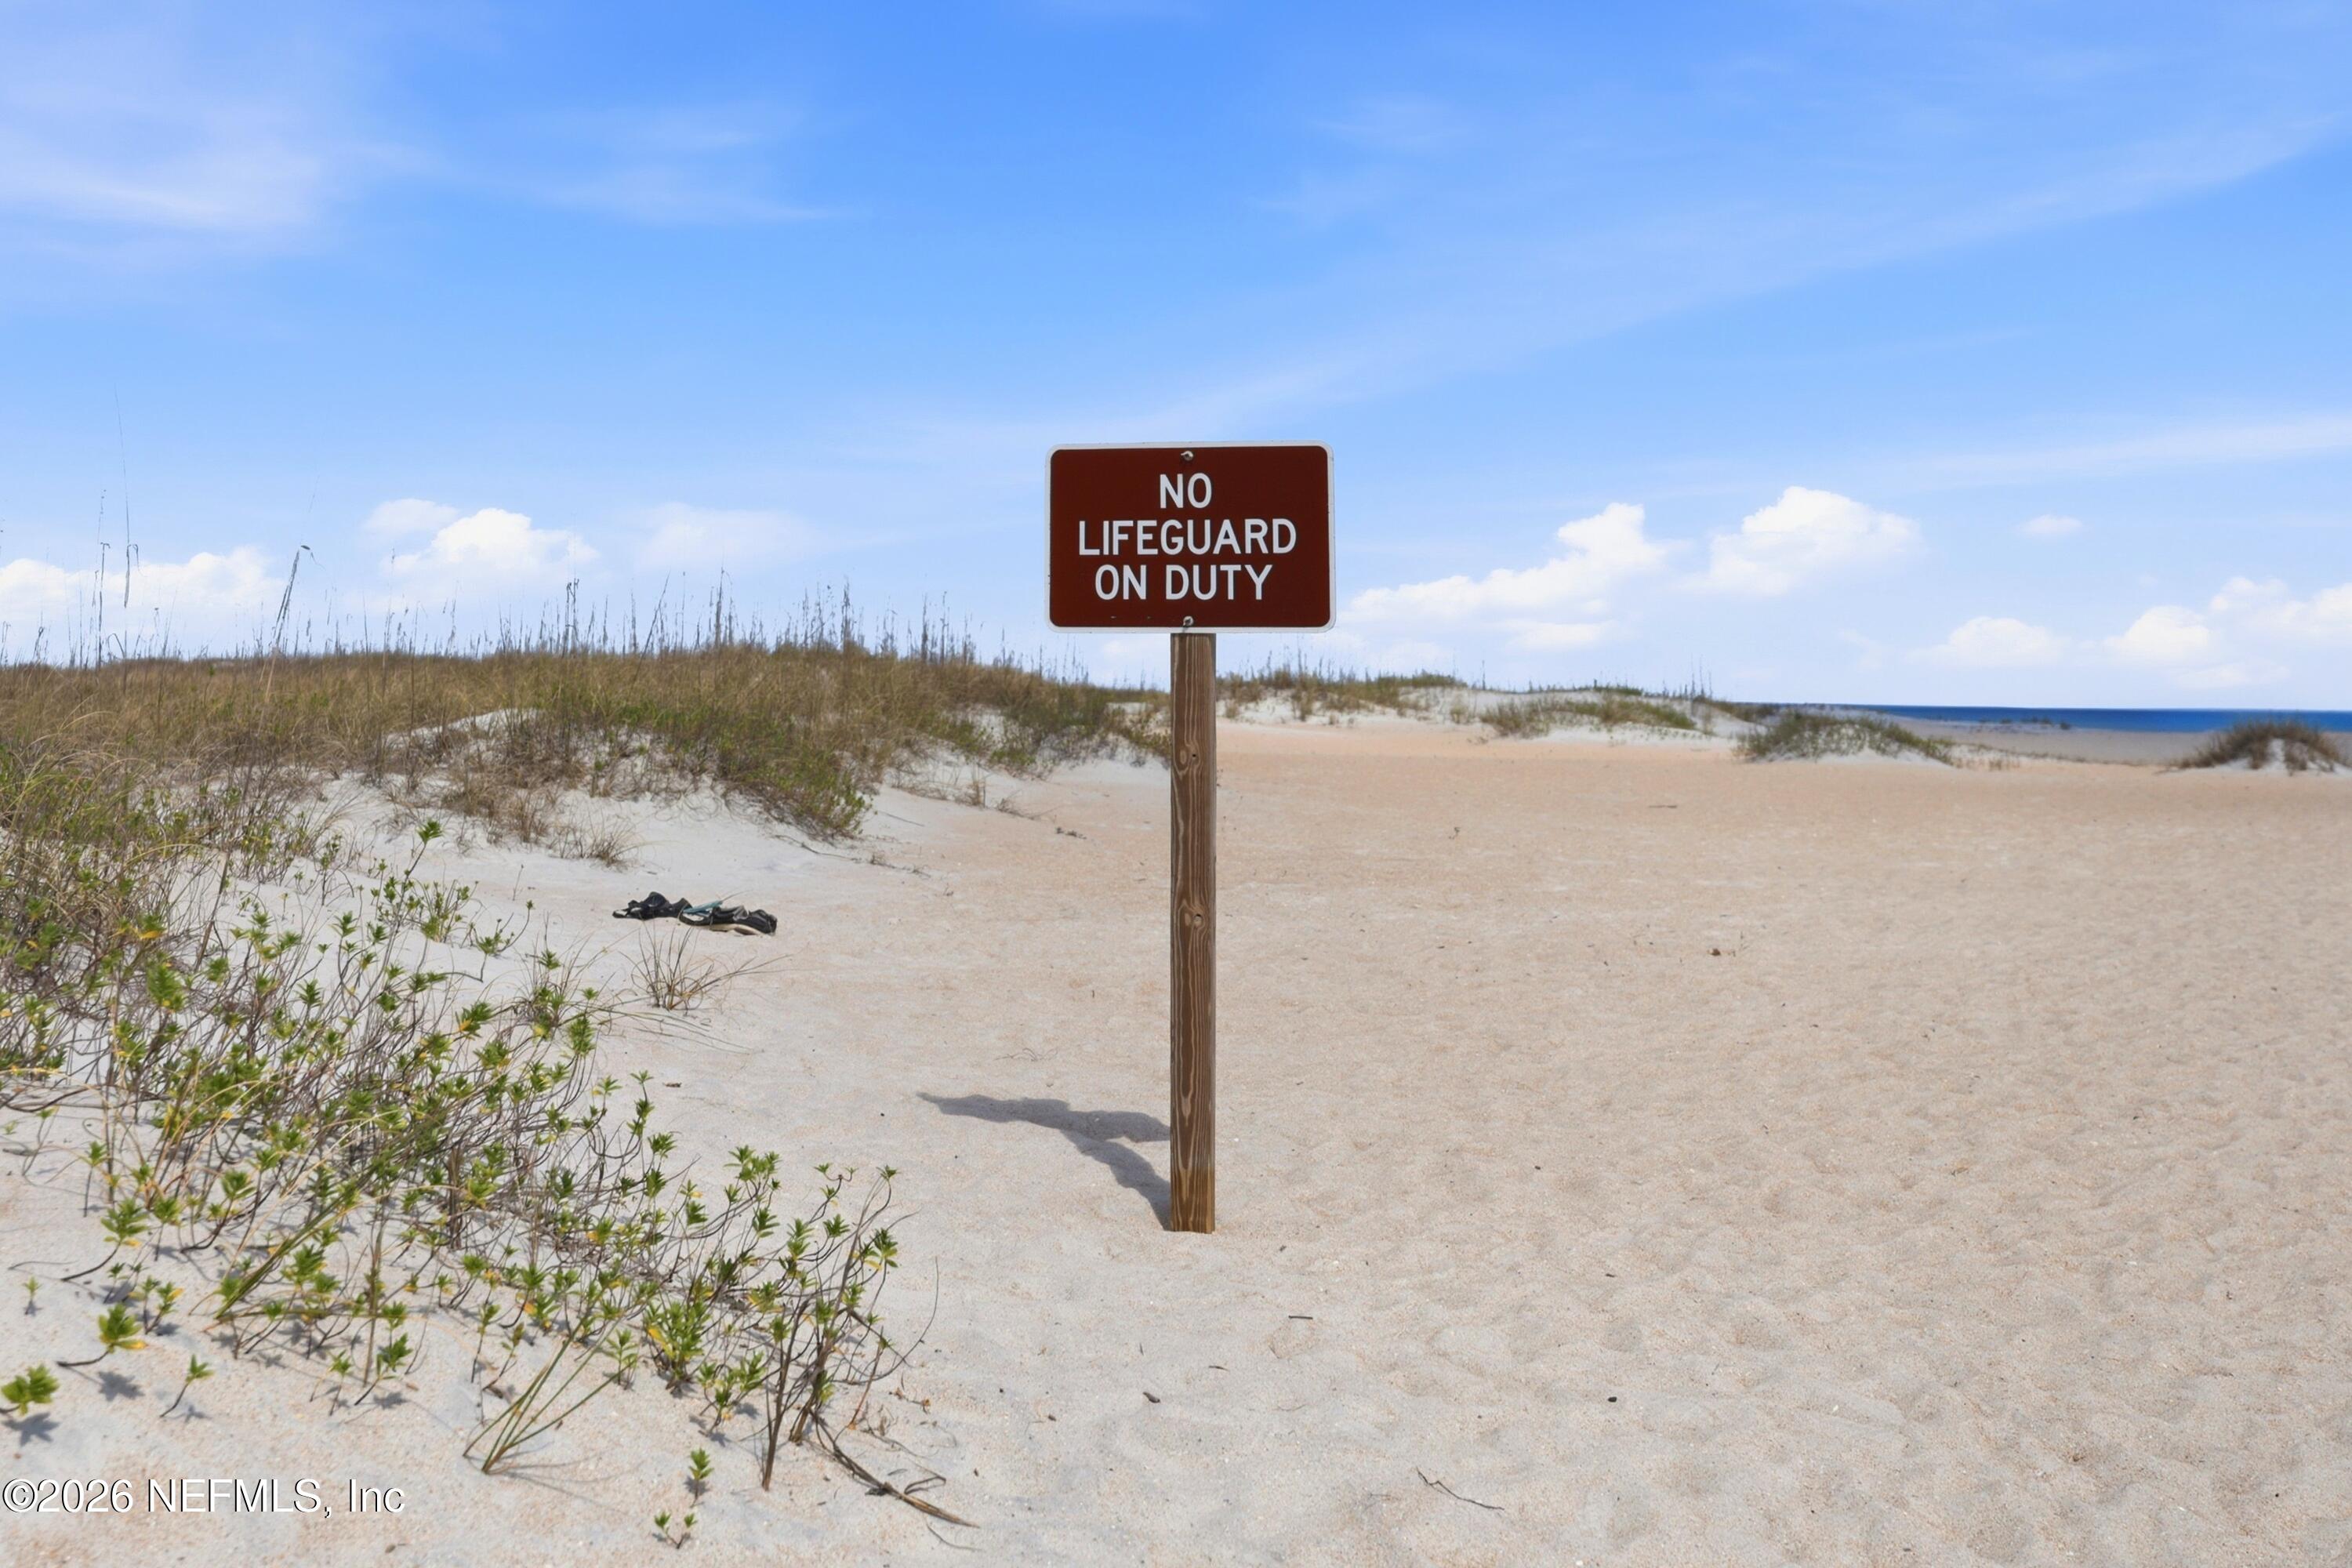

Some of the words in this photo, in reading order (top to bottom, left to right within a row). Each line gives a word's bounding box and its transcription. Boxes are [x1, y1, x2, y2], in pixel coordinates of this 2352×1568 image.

[1159, 472, 1212, 509] NO
[1079, 518, 1298, 556] LIFEGUARD
[1094, 564, 1147, 601] ON
[1165, 564, 1273, 601] DUTY
